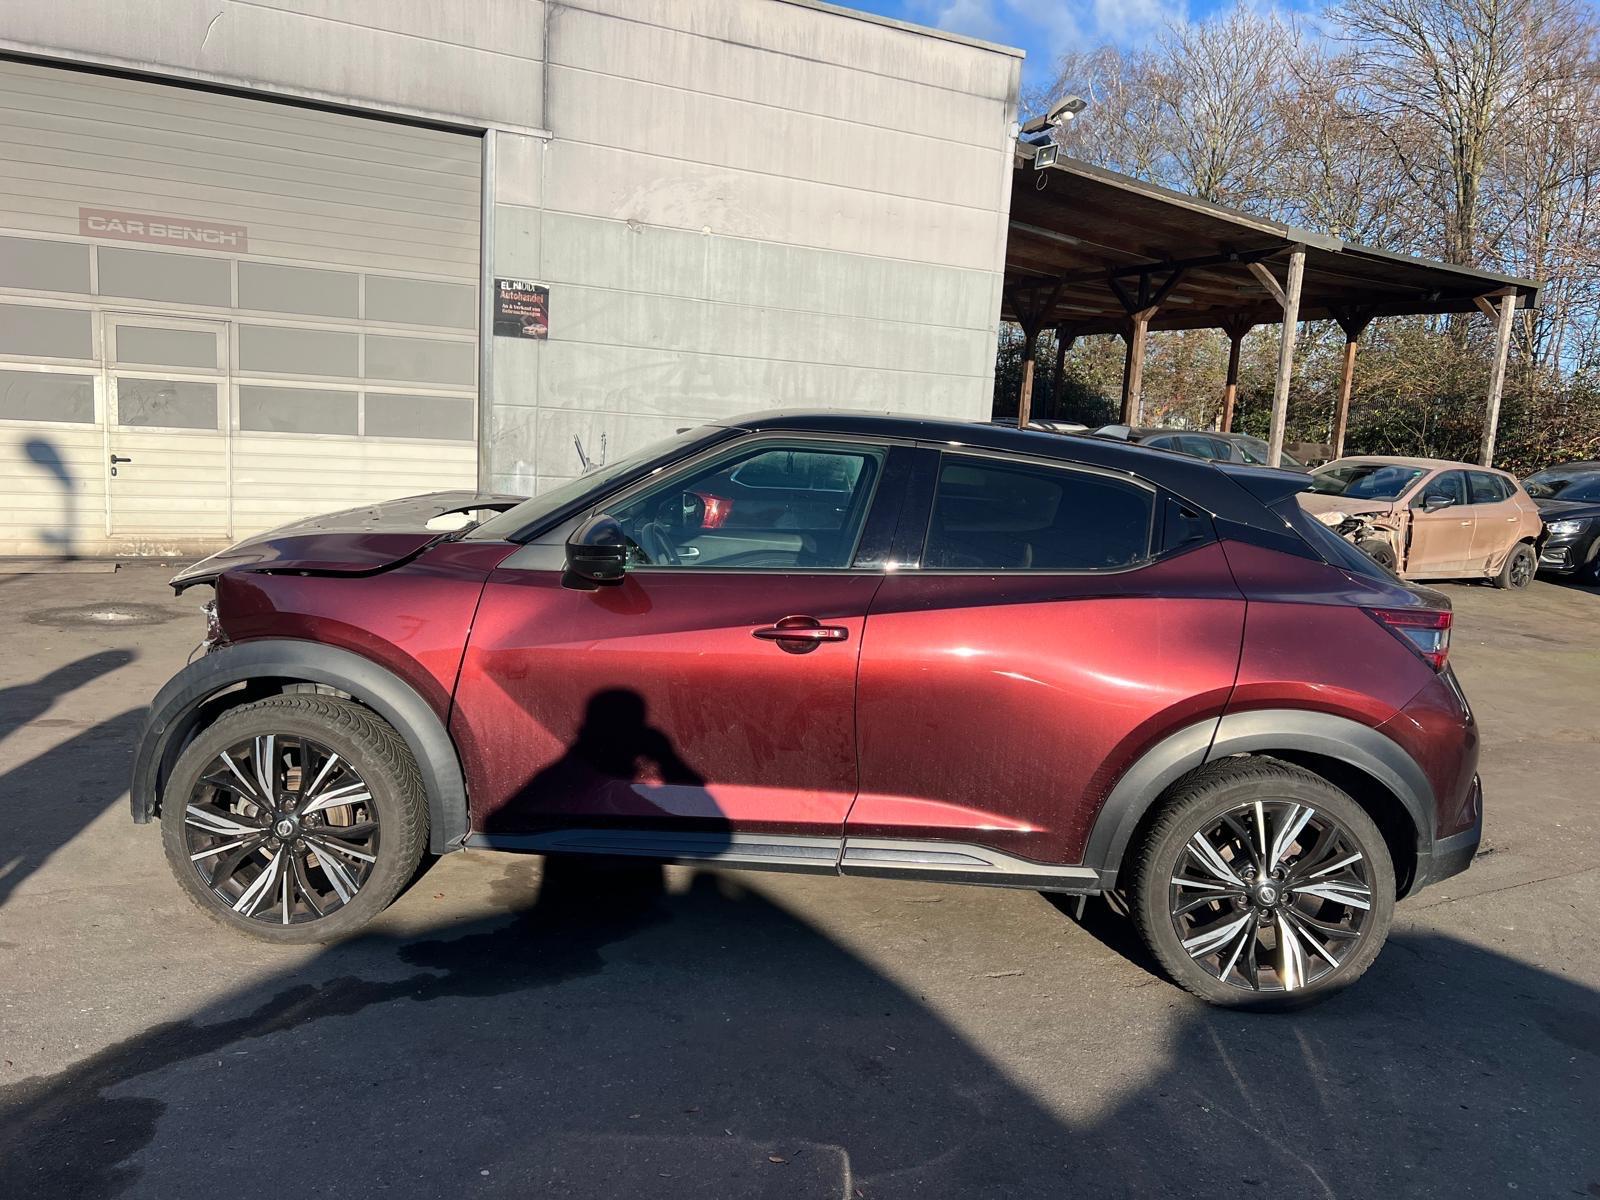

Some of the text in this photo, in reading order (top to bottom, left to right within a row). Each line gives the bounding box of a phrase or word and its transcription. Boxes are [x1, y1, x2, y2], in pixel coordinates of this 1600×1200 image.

[88, 216, 237, 245] CAR BENCH
[500, 291, 544, 303] Autohandel
